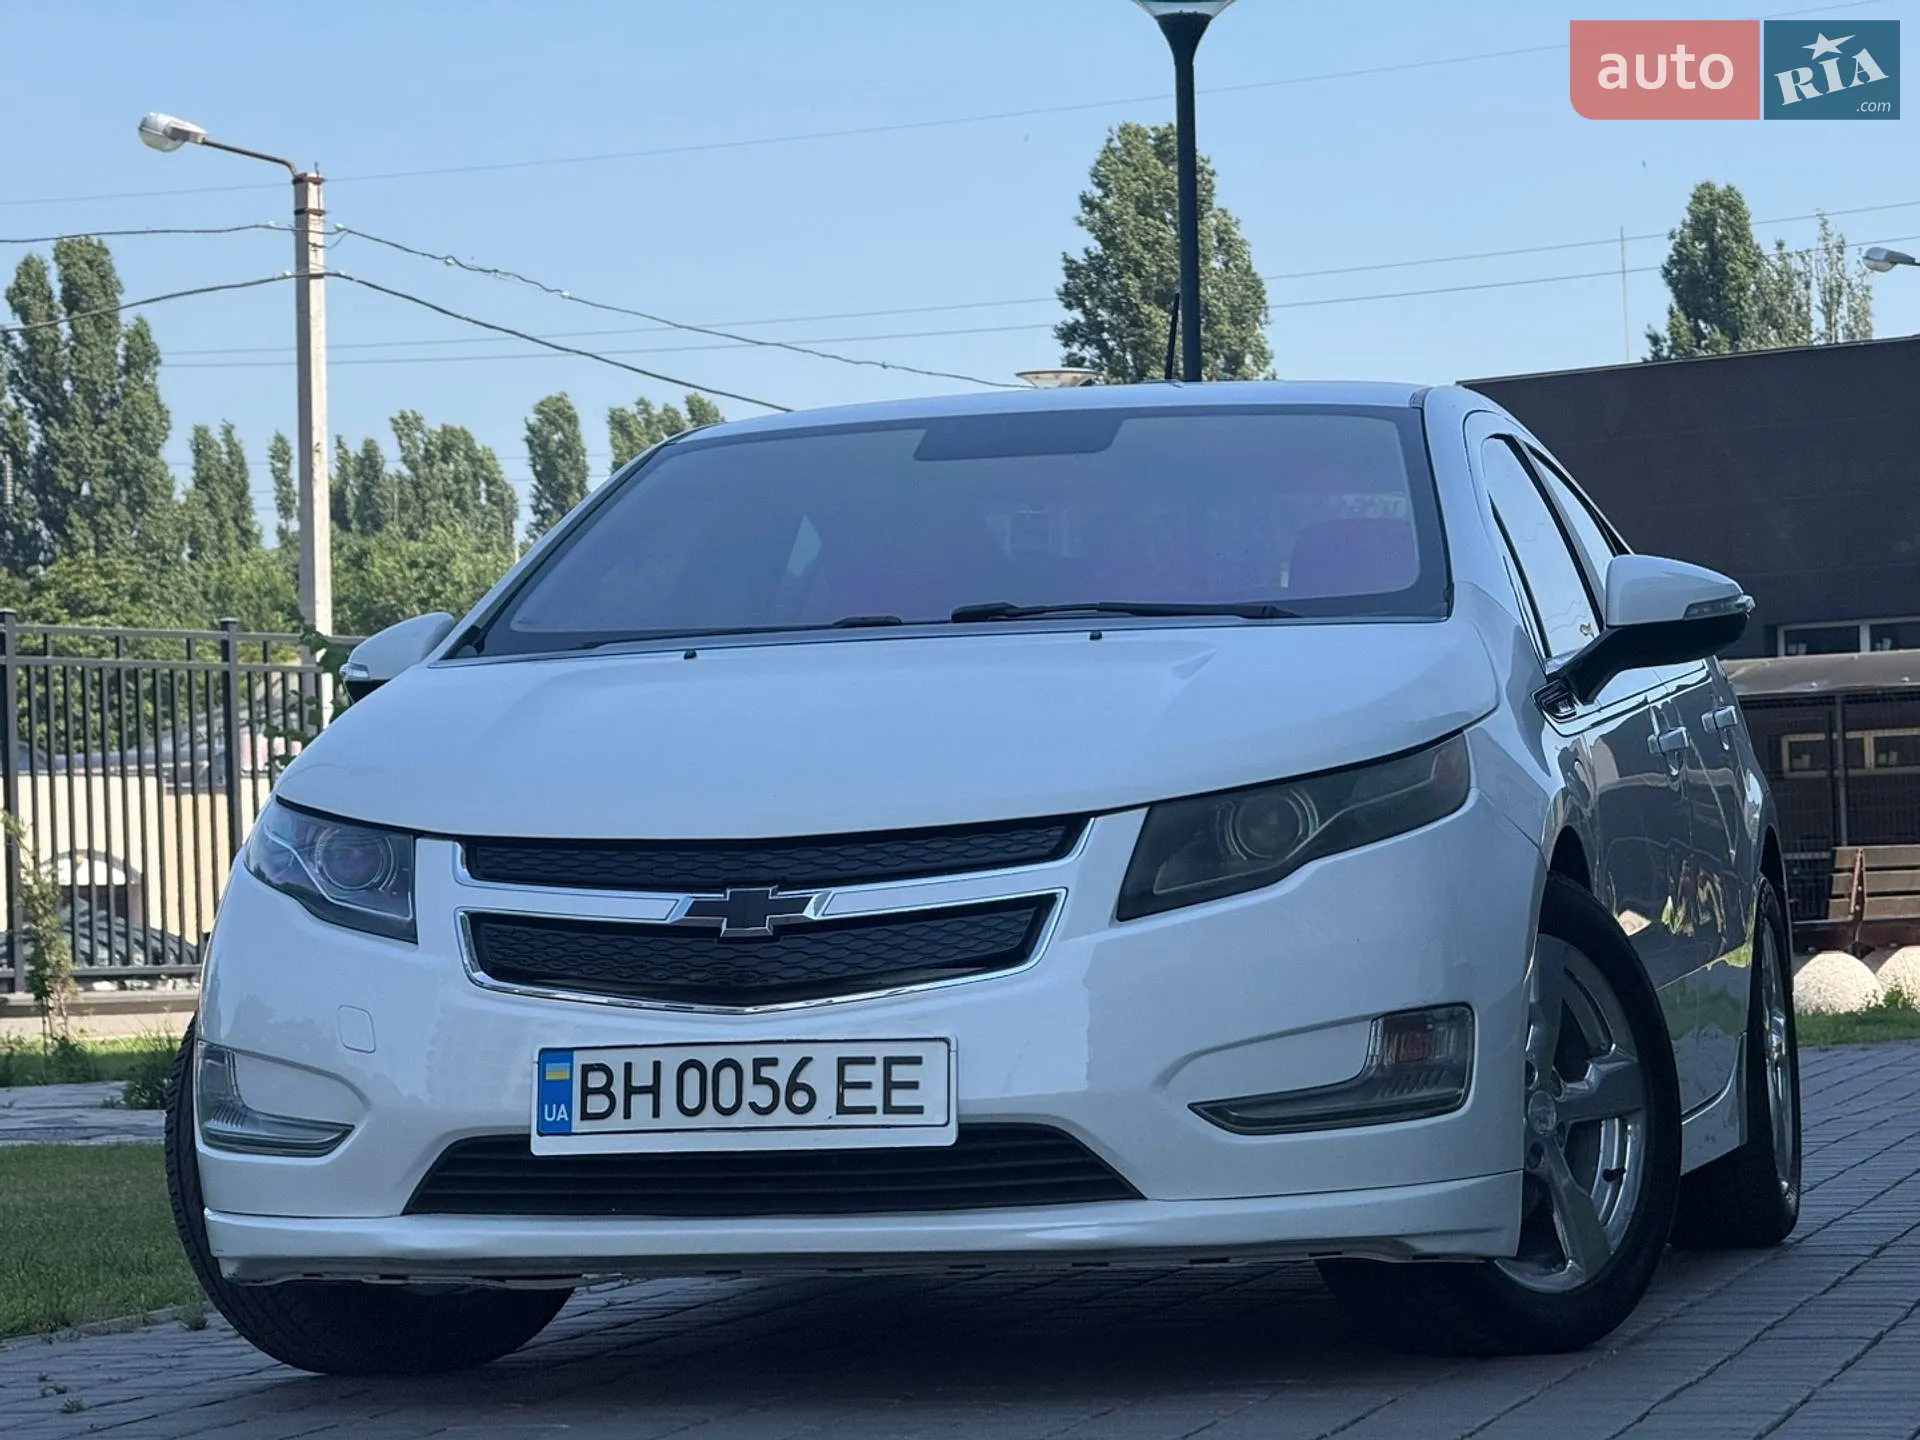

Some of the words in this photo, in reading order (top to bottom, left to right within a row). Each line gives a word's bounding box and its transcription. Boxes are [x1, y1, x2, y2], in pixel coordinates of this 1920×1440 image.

[579, 1059, 662, 1121] BH
[675, 1056, 818, 1117] 0056
[835, 1055, 925, 1116] EE
[543, 1103, 569, 1122] UA
